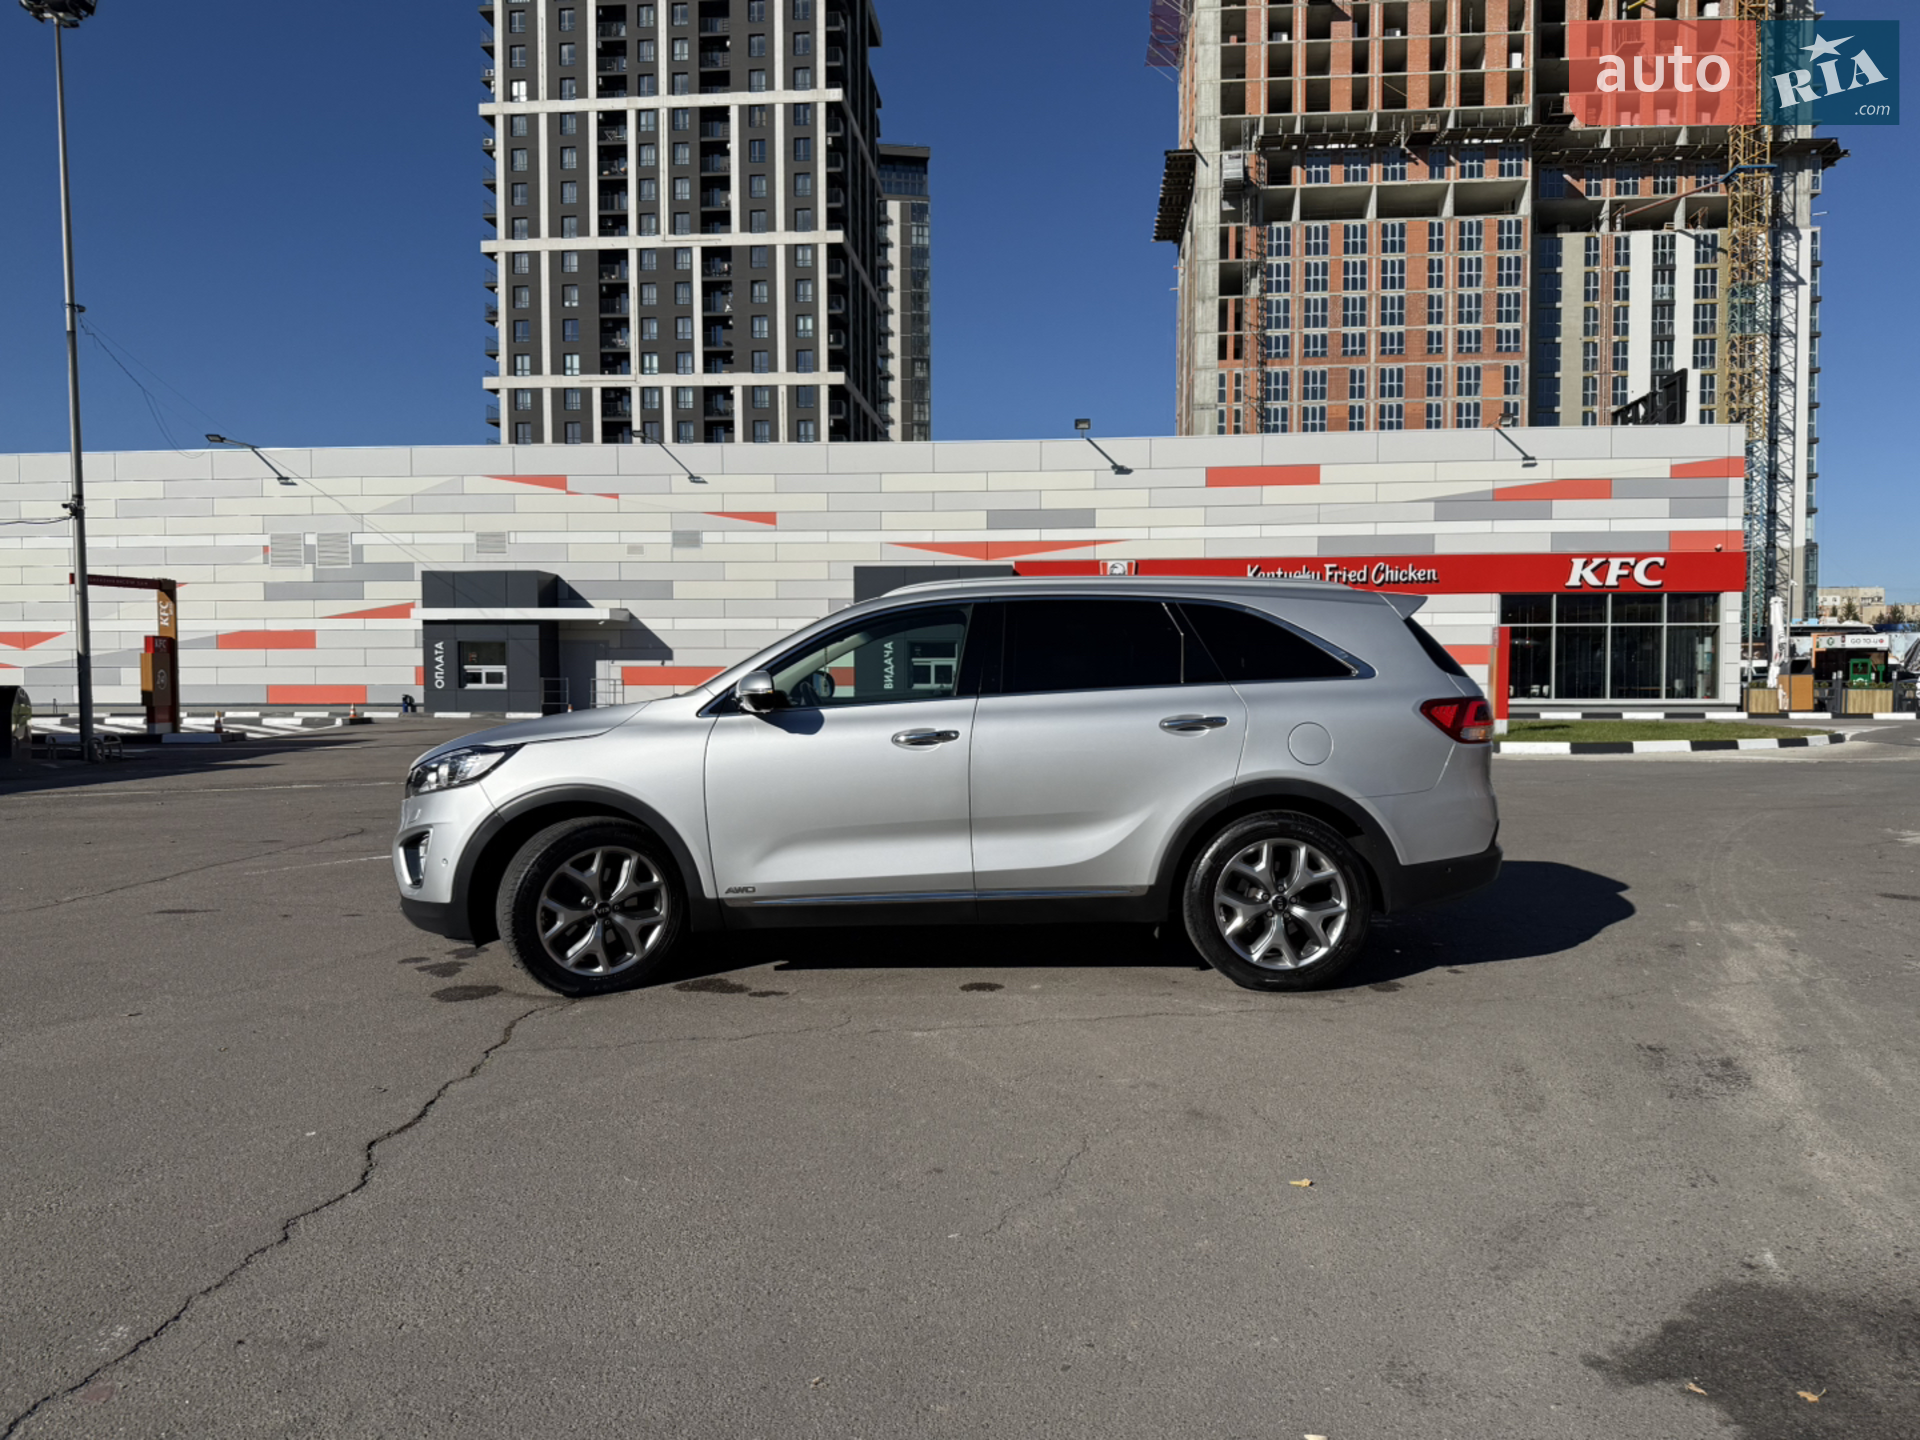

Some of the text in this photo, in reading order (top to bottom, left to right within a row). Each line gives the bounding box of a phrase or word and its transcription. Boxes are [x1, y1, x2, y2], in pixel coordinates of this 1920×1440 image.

[1323, 564, 1368, 583] Fried
[1371, 562, 1438, 585] Chicken
[1564, 557, 1666, 588] KFC
[158, 600, 171, 628] KFC
[434, 640, 445, 690] ОПЛАТА
[883, 641, 895, 690] ВИДАЧА
[725, 886, 756, 894] AWD
